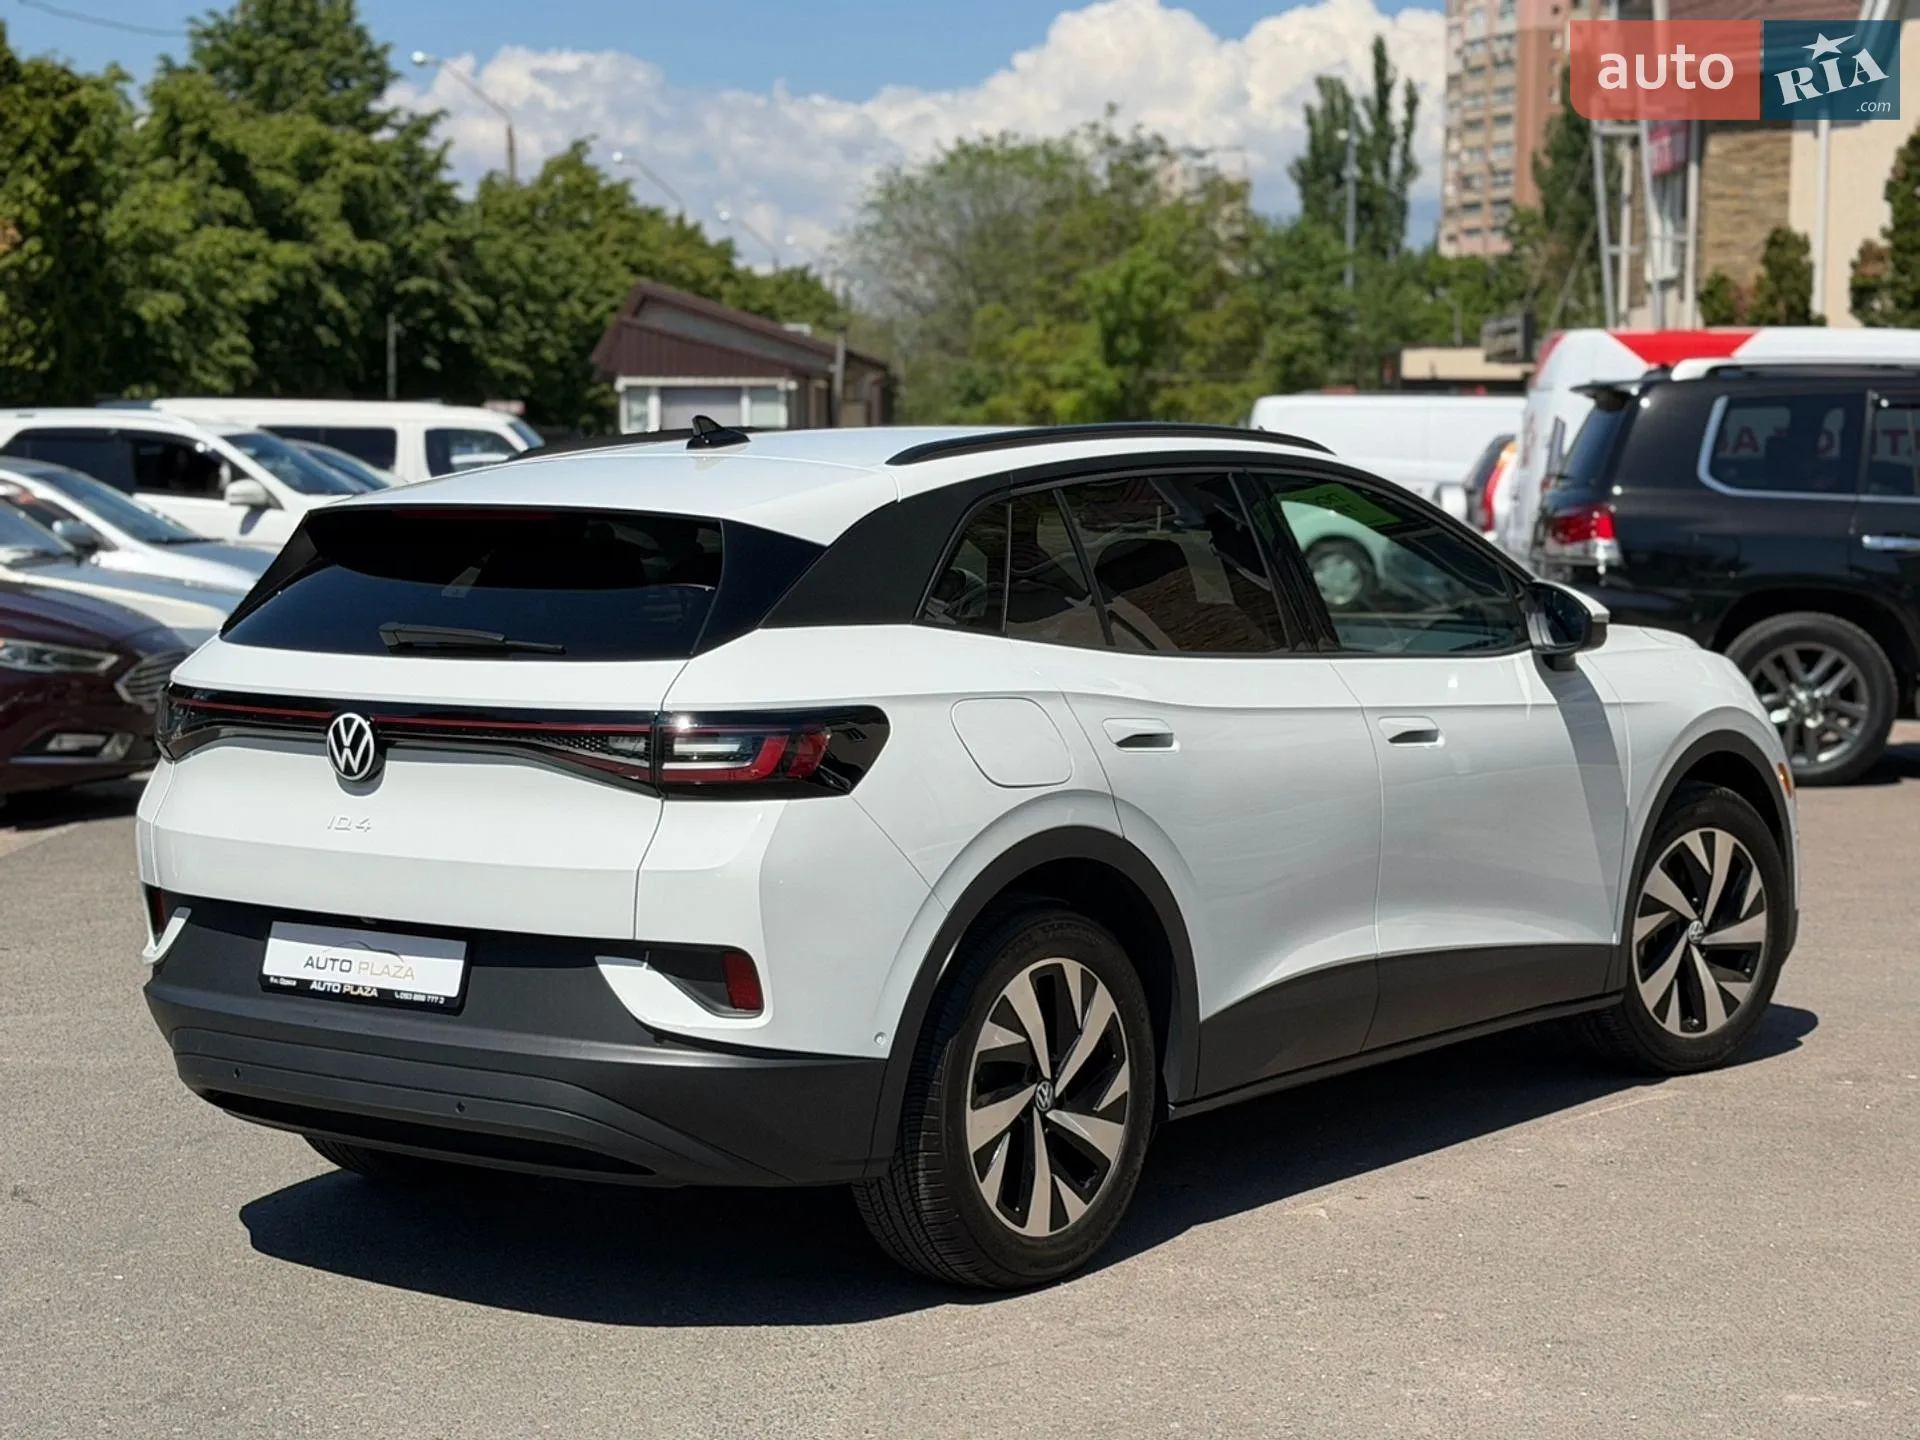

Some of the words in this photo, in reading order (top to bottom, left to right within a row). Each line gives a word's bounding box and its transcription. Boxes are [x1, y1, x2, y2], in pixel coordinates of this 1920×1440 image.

[303, 955, 353, 974] AUTO
[357, 961, 416, 981] PLAZA
[309, 980, 341, 994] AUTO
[342, 984, 379, 998] PLAZA
